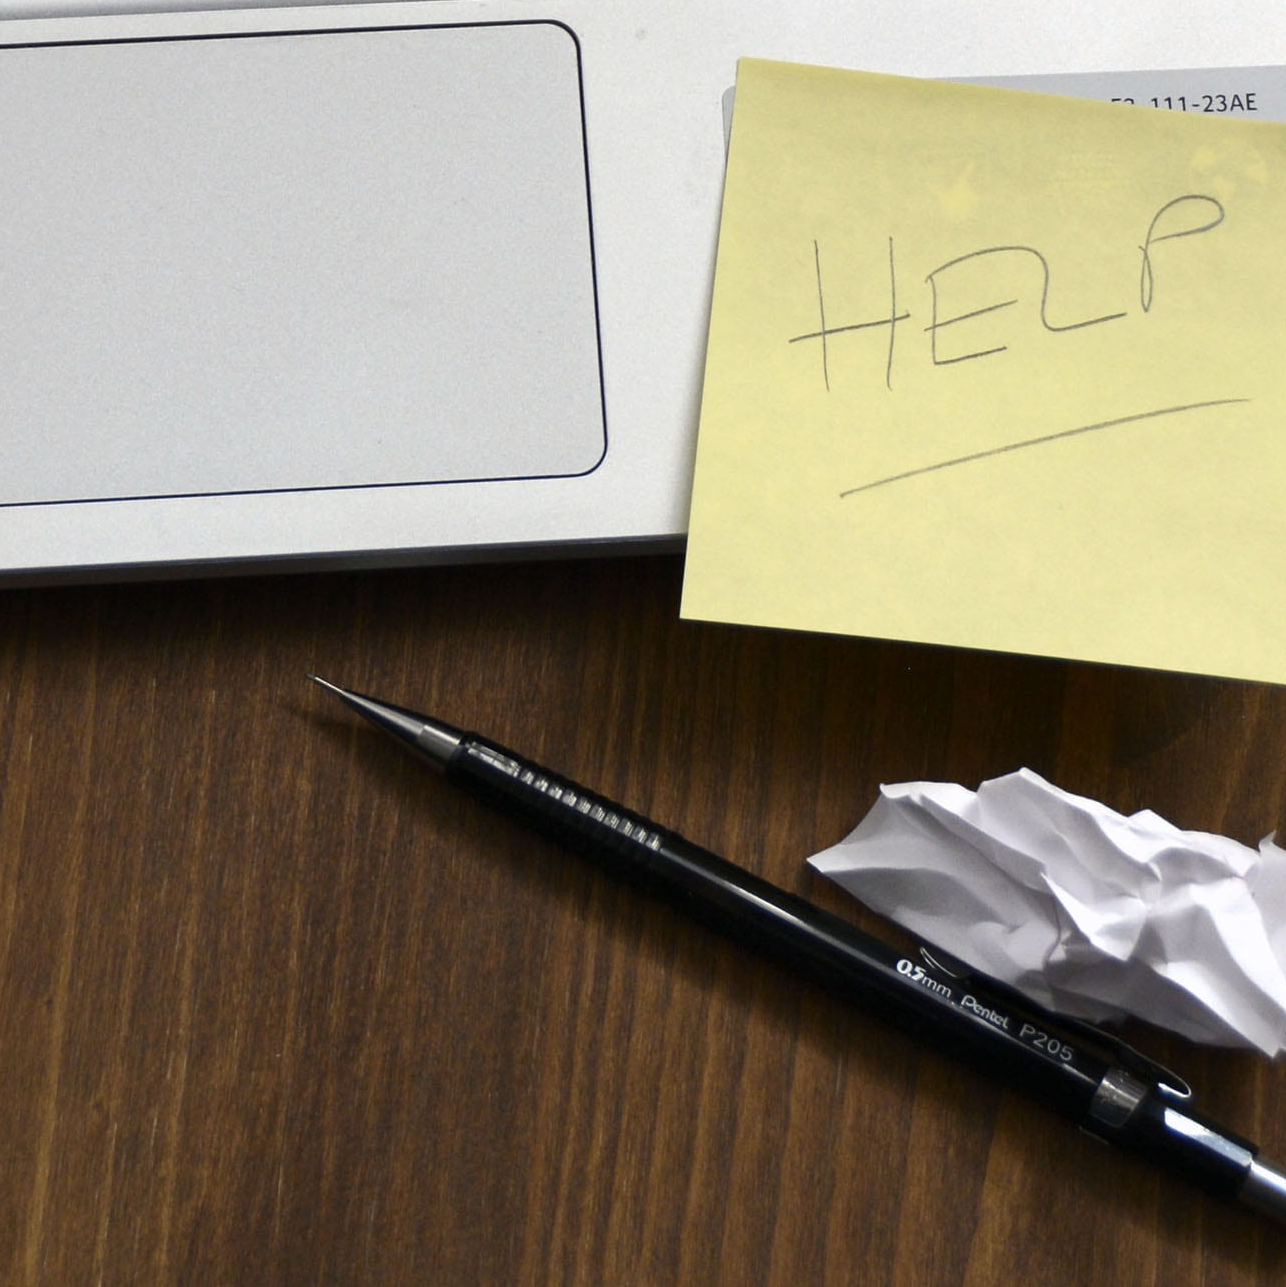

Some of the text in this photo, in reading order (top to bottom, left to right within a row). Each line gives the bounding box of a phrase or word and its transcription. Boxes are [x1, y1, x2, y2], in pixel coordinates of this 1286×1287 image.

[787, 193, 1226, 392] HELP
[896, 958, 1074, 1062] 0.5mm Pentel P205
